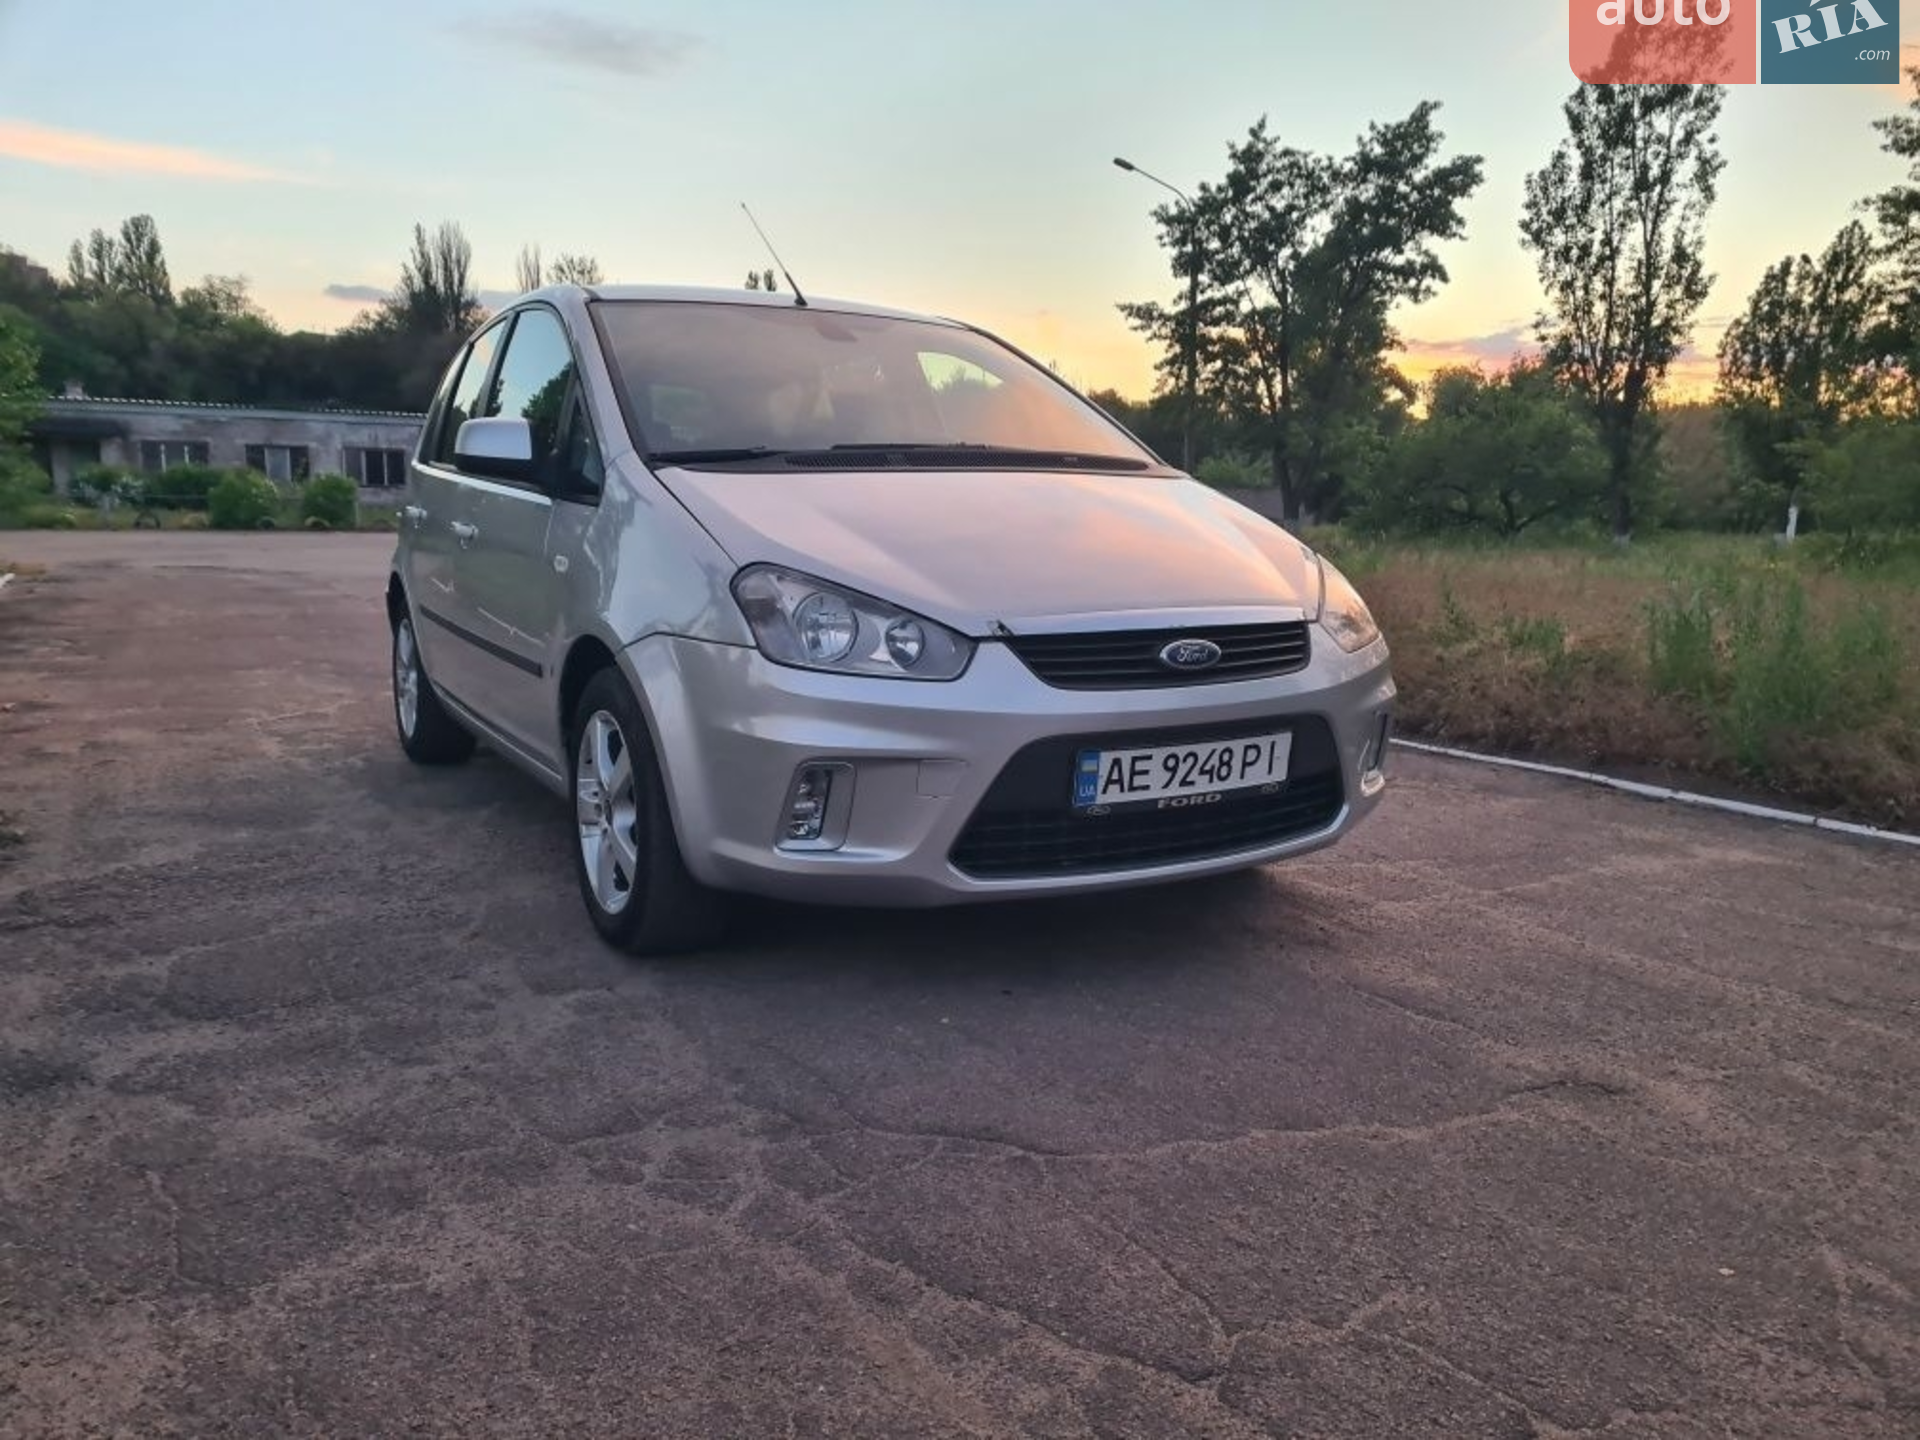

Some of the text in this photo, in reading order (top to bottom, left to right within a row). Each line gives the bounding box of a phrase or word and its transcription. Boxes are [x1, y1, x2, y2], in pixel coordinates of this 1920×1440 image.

[1177, 645, 1209, 662] Ford
[1101, 741, 1276, 795] AE 9248 PI
[1079, 784, 1096, 797] UA
[1157, 793, 1222, 809] FORD
